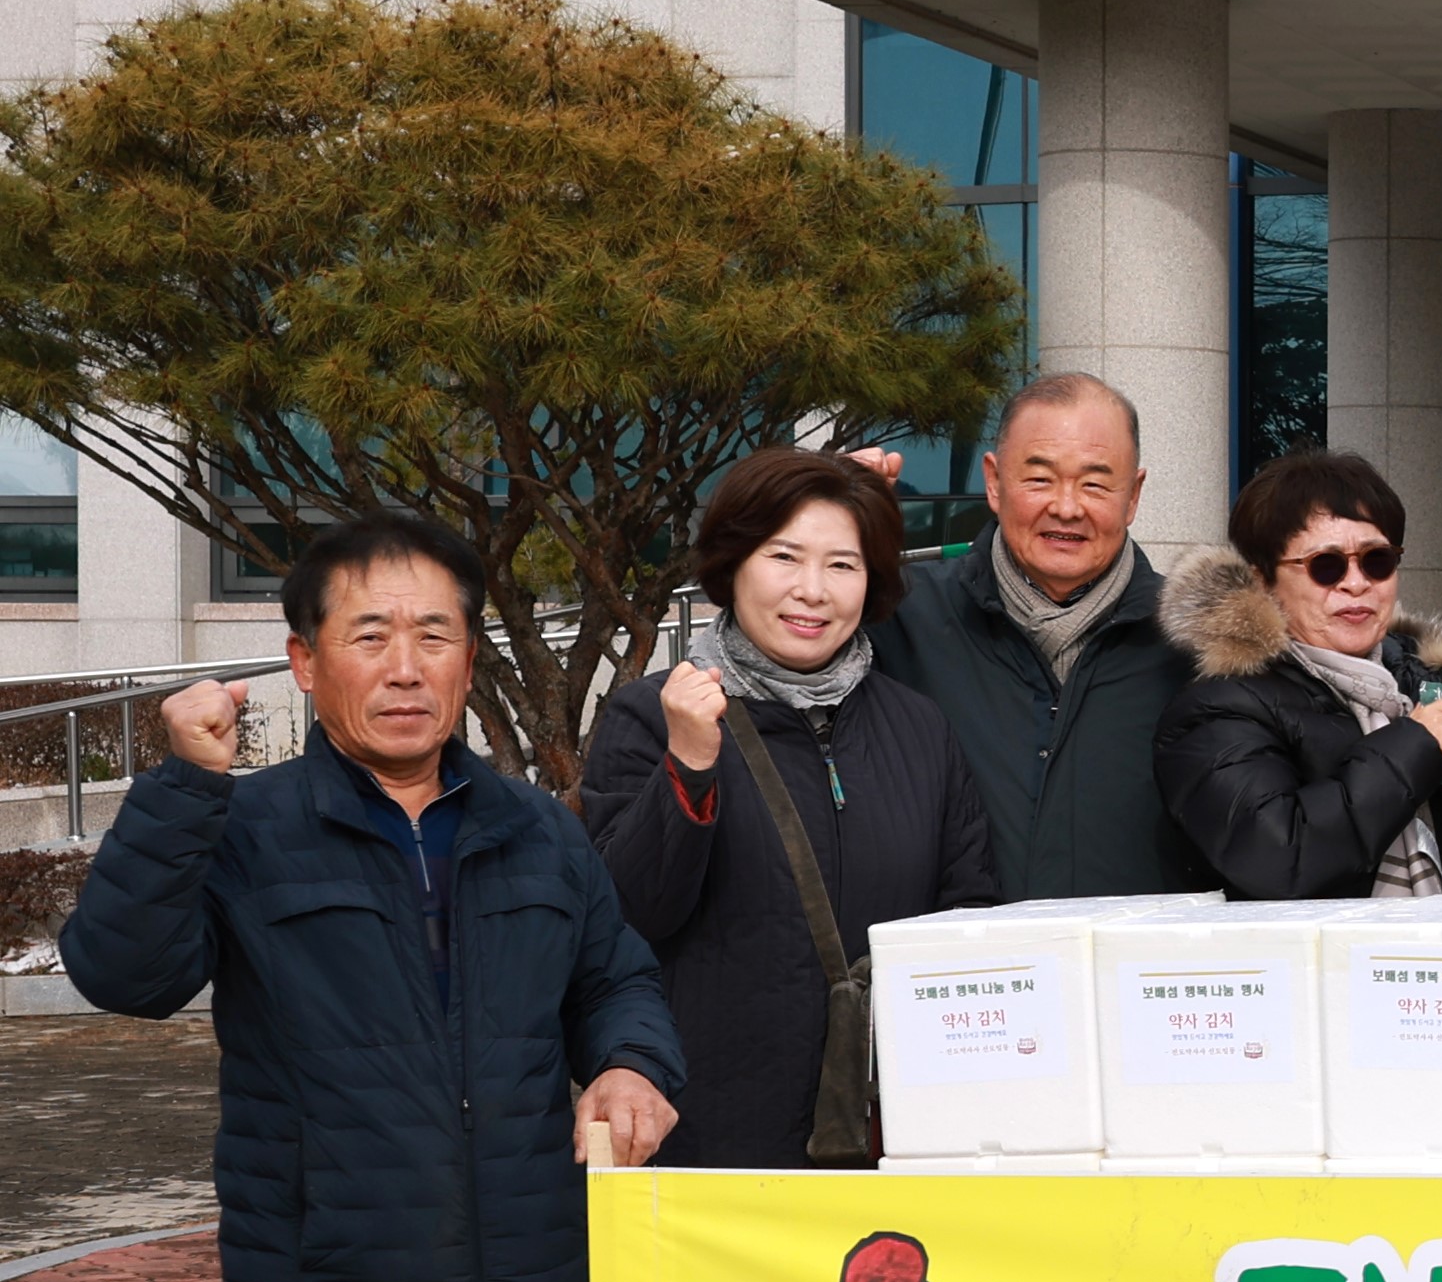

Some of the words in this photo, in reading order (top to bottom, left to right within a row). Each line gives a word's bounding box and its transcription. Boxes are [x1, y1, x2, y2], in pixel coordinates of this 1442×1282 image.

[1397, 998, 1427, 1015] 약사
[941, 1011, 971, 1030] 약사
[977, 1008, 1006, 1027] 김치
[1168, 1013, 1198, 1030] 약사
[1205, 1012, 1233, 1029] 김치
